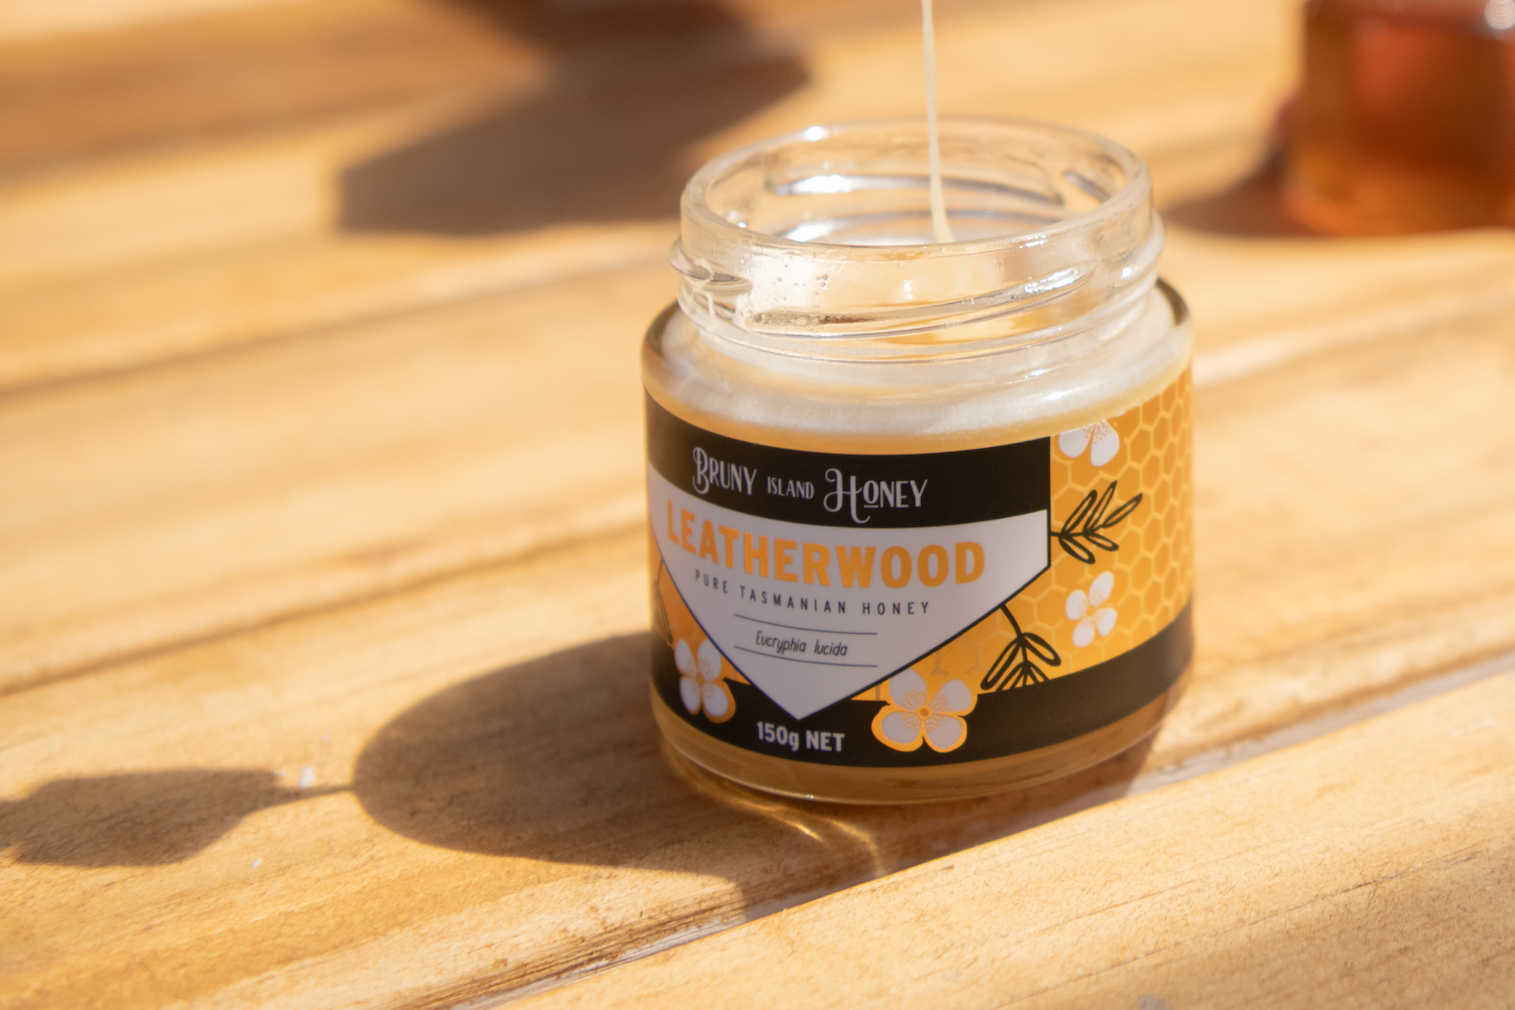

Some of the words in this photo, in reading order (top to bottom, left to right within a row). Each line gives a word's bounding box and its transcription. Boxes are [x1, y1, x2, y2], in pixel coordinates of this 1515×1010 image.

[692, 447, 757, 495] BRUNY
[767, 476, 815, 500] ISLAND
[823, 468, 929, 524] HONEY
[667, 500, 986, 589] LEATHERWOOD
[695, 569, 729, 594] PURE
[739, 585, 847, 614] TASMANIAN
[862, 601, 930, 616] HONEY
[755, 630, 806, 654] Eucryphia
[813, 640, 848, 656] lucida
[756, 722, 800, 751] 150g
[805, 731, 845, 752] NET
